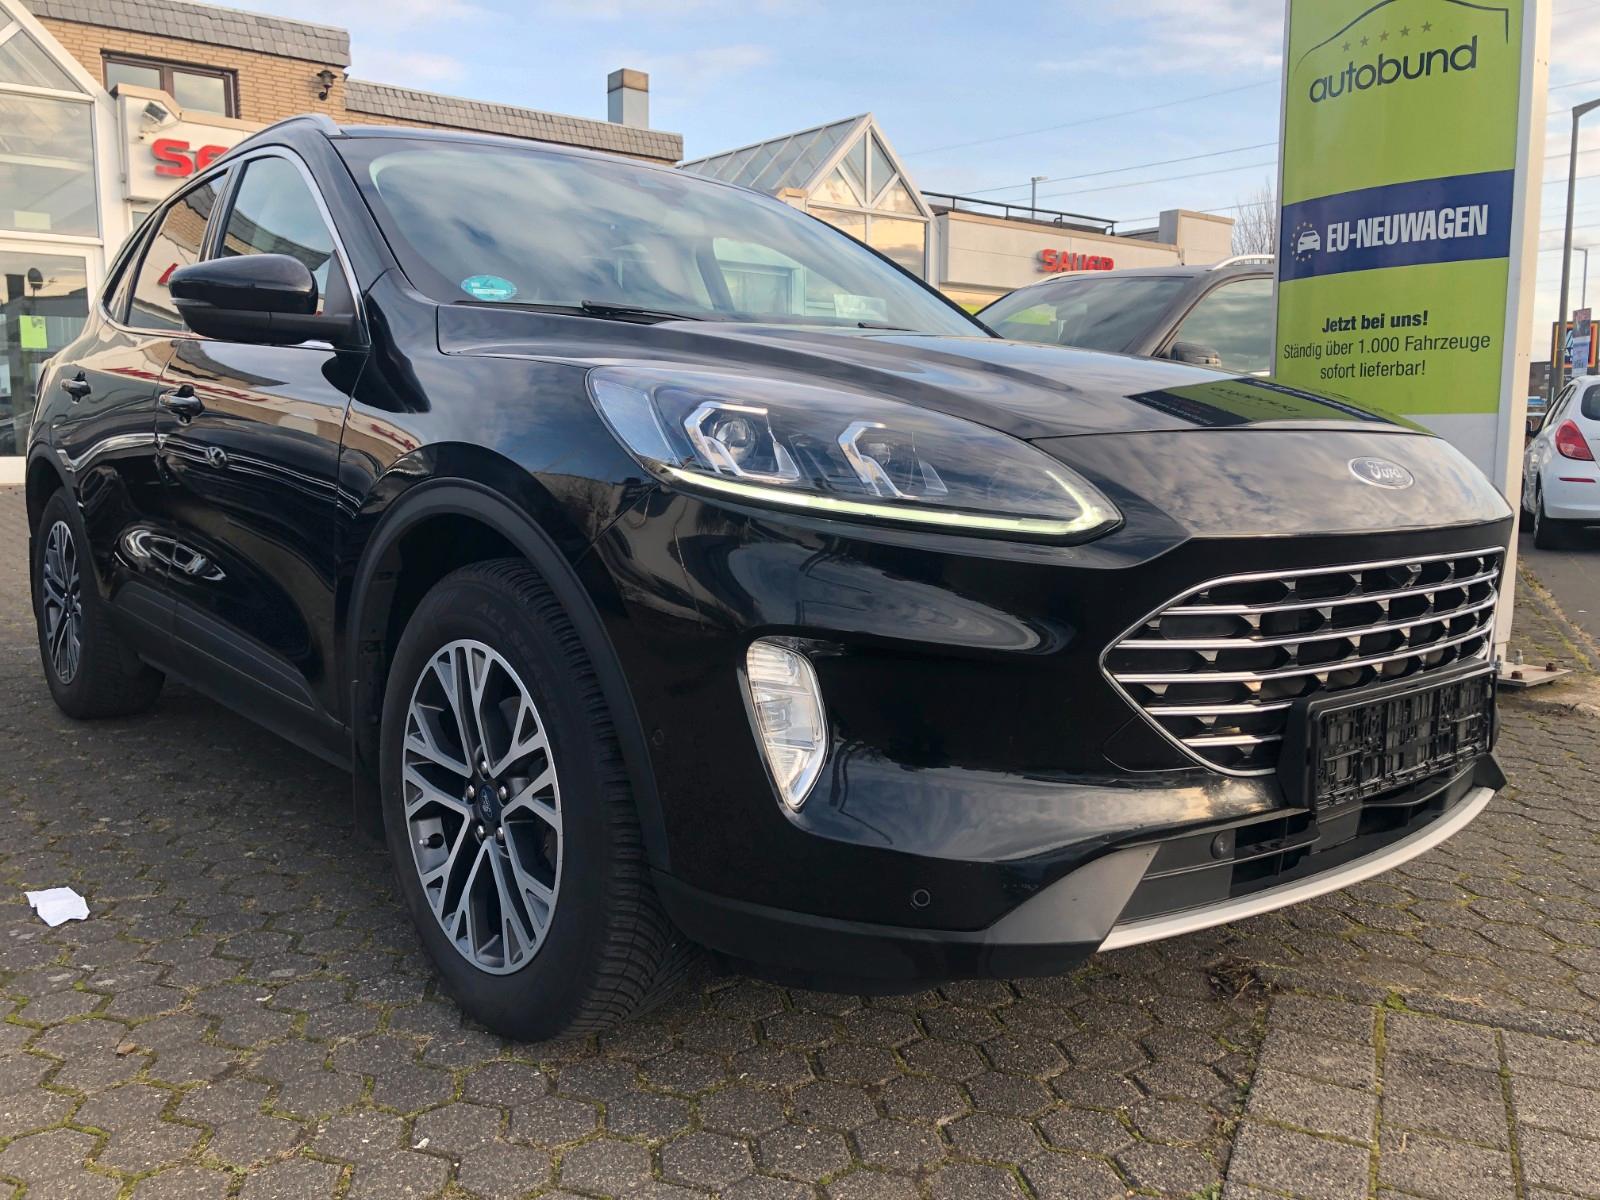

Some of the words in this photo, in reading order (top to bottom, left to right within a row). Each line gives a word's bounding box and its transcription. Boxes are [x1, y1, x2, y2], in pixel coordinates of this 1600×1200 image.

[1309, 35, 1478, 103] autobund
[1326, 204, 1489, 253] EU-NEUWAGEN
[1322, 315, 1357, 333] Jetzt
[1361, 313, 1385, 330] bei
[1390, 310, 1429, 329] uns!
[1283, 341, 1322, 360] Ständig
[1325, 339, 1354, 357] über
[1358, 336, 1400, 355] 1.000
[1404, 333, 1491, 352] Fahrzeuge
[1320, 363, 1356, 380] sofort
[1360, 360, 1426, 378] lieferbar!
